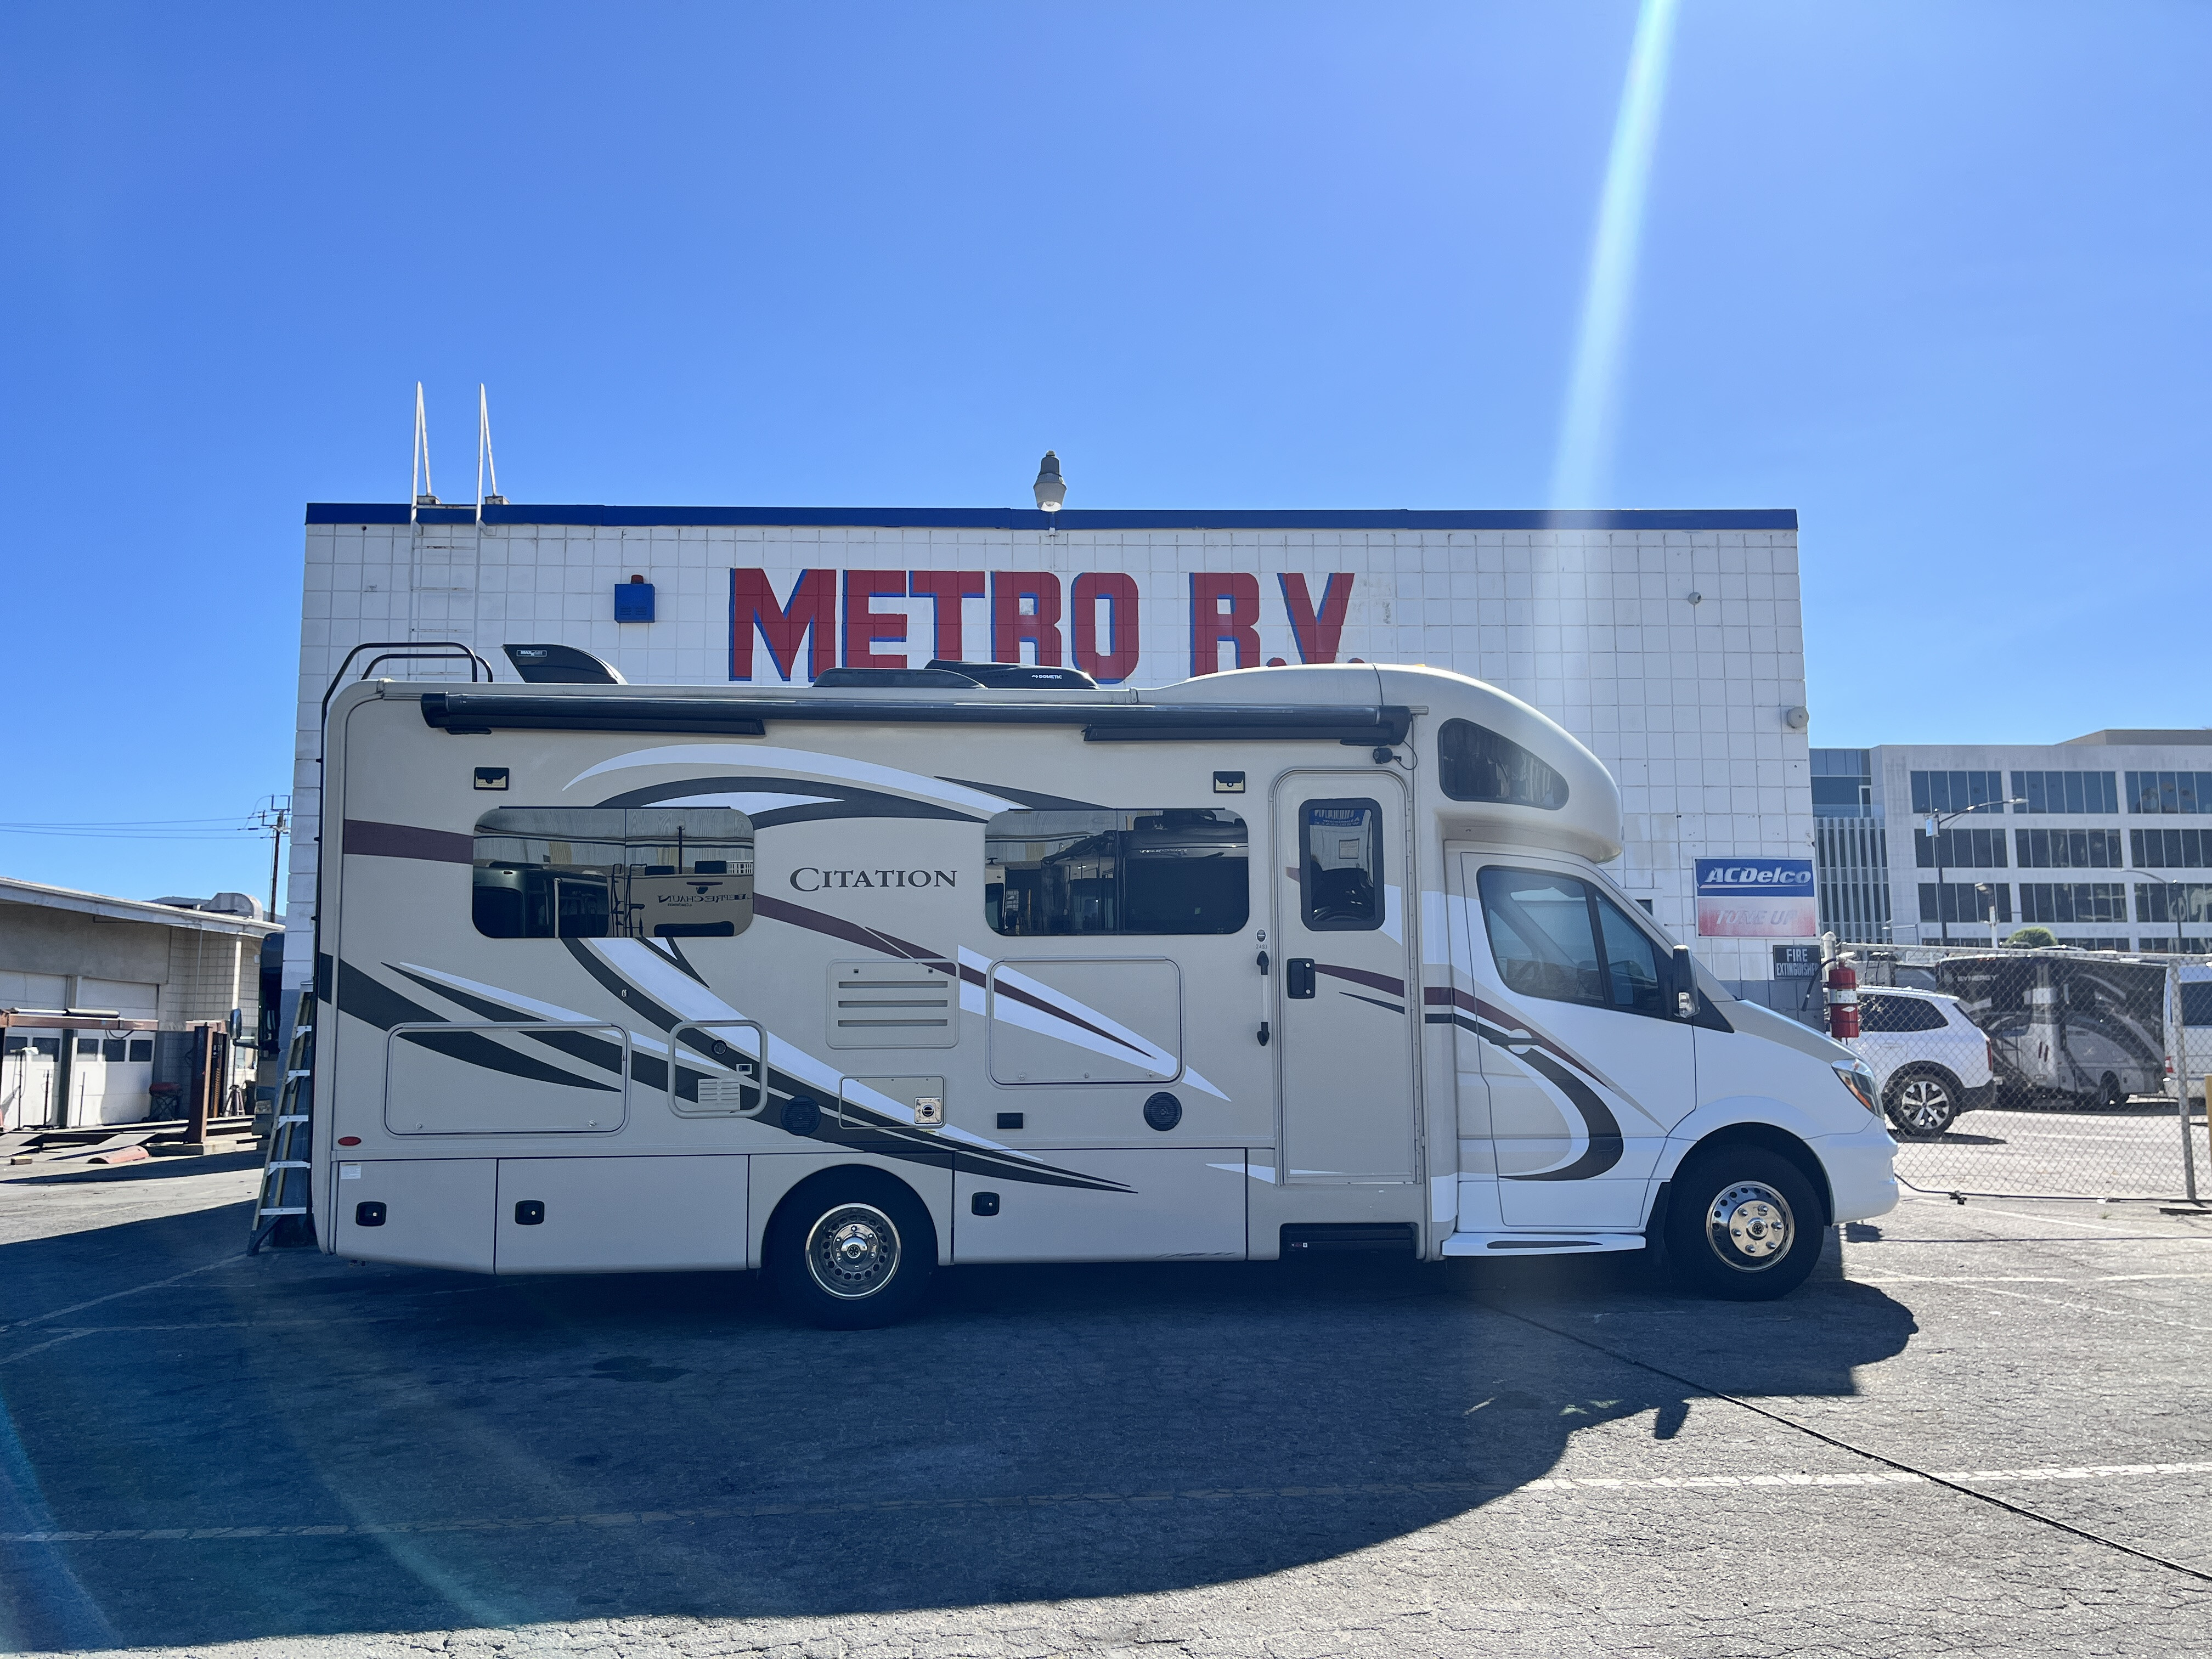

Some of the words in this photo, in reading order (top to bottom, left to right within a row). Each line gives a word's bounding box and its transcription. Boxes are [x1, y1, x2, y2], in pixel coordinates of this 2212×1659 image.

[729, 568, 1139, 684] METRO
[1189, 572, 1365, 678] RV
[790, 867, 958, 891] CITATION
[1705, 867, 1812, 884] ACDelco
[1716, 910, 1768, 925] TUNE
[1770, 910, 1798, 925] UP
[1786, 948, 1808, 962] FIRE
